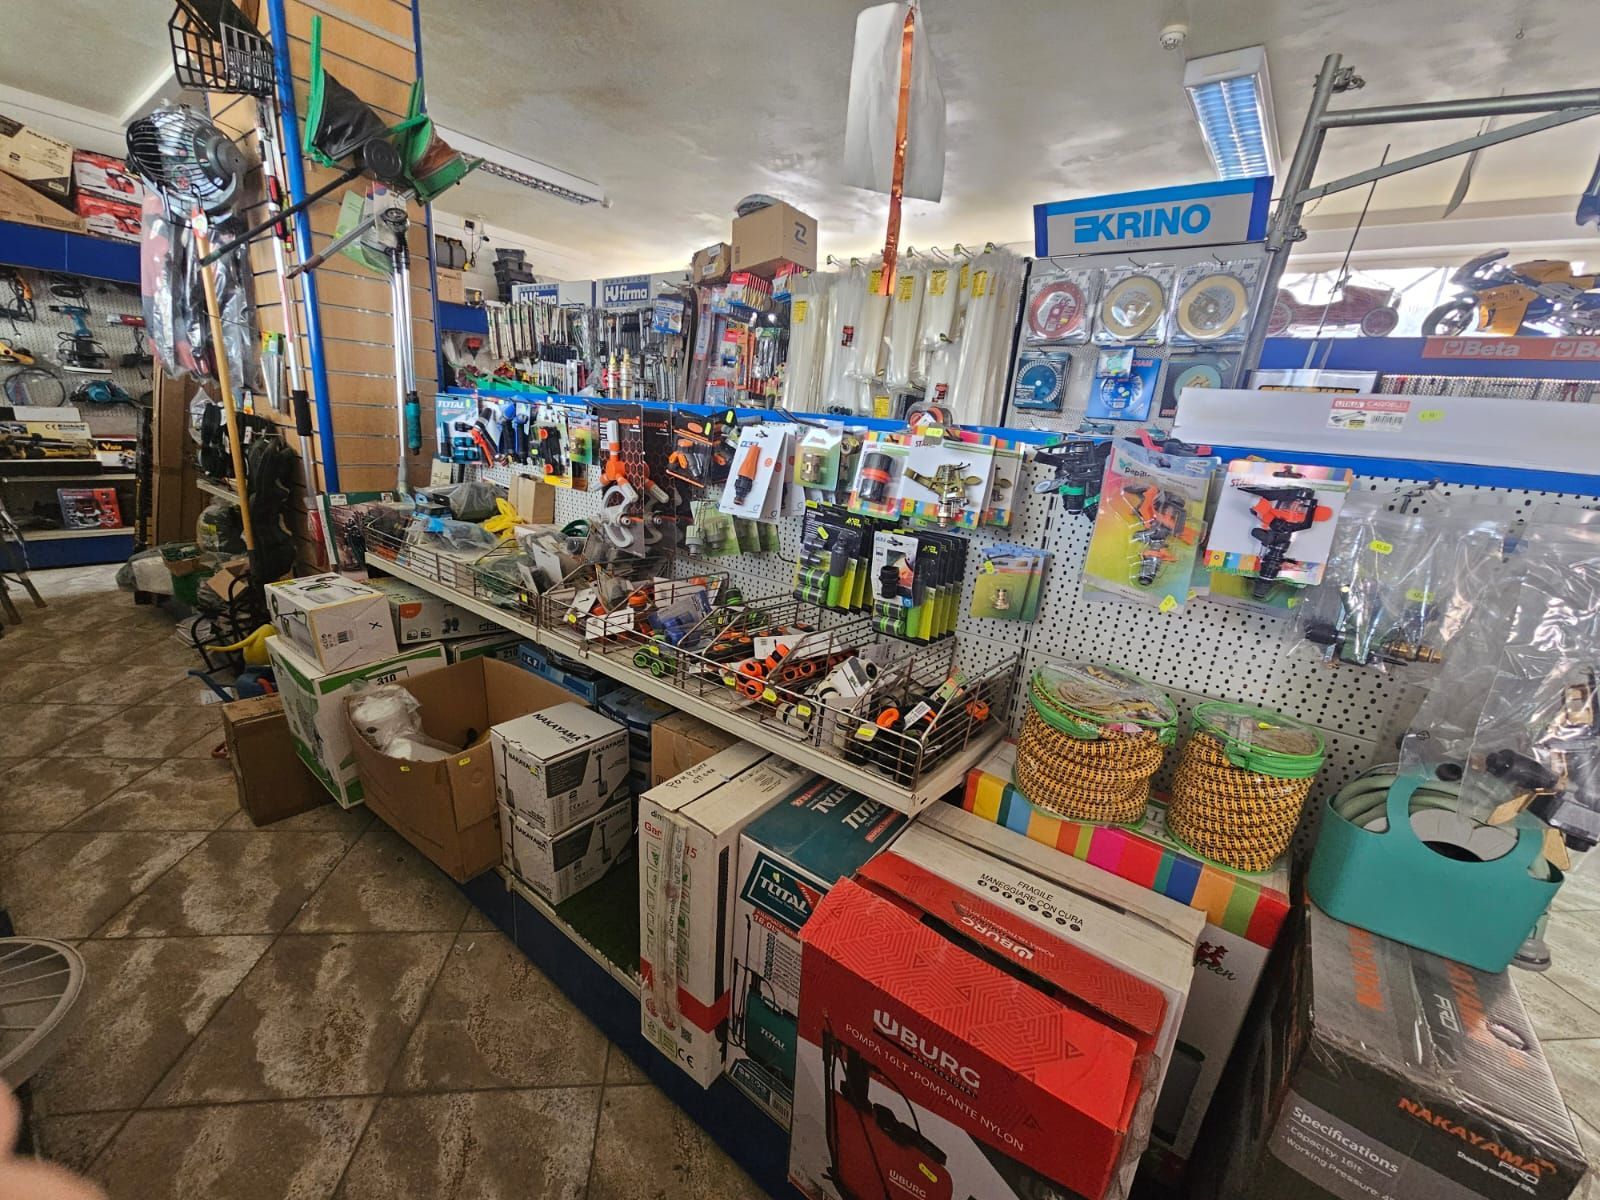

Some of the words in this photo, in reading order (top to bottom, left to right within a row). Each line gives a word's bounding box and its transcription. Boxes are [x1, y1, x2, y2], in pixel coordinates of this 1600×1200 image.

[1074, 203, 1211, 244] KRINO
[1462, 340, 1520, 356] Beta
[437, 400, 466, 409] TOTAL
[376, 674, 397, 686] 310
[533, 713, 581, 742] NAKAYAMA
[759, 875, 808, 915] TOTAL
[979, 873, 1036, 903] MANEGGIARE
[1037, 899, 1058, 913] CON
[1058, 908, 1084, 927] CURA
[1017, 881, 1054, 901] FRAGILE
[760, 1026, 786, 1049] TOTAL
[845, 1023, 881, 1055] POMPA
[884, 1051, 909, 1073] 16LT
[913, 1071, 978, 1120] POMPANTE
[980, 1115, 1025, 1151] NYLON
[1286, 1136, 1327, 1167] Working
[1290, 1126, 1339, 1159] Capacity:
[1292, 1106, 1400, 1173] Specifications
[1398, 1097, 1541, 1177] NAKAYAMA
[1498, 1160, 1540, 1185] PRO
